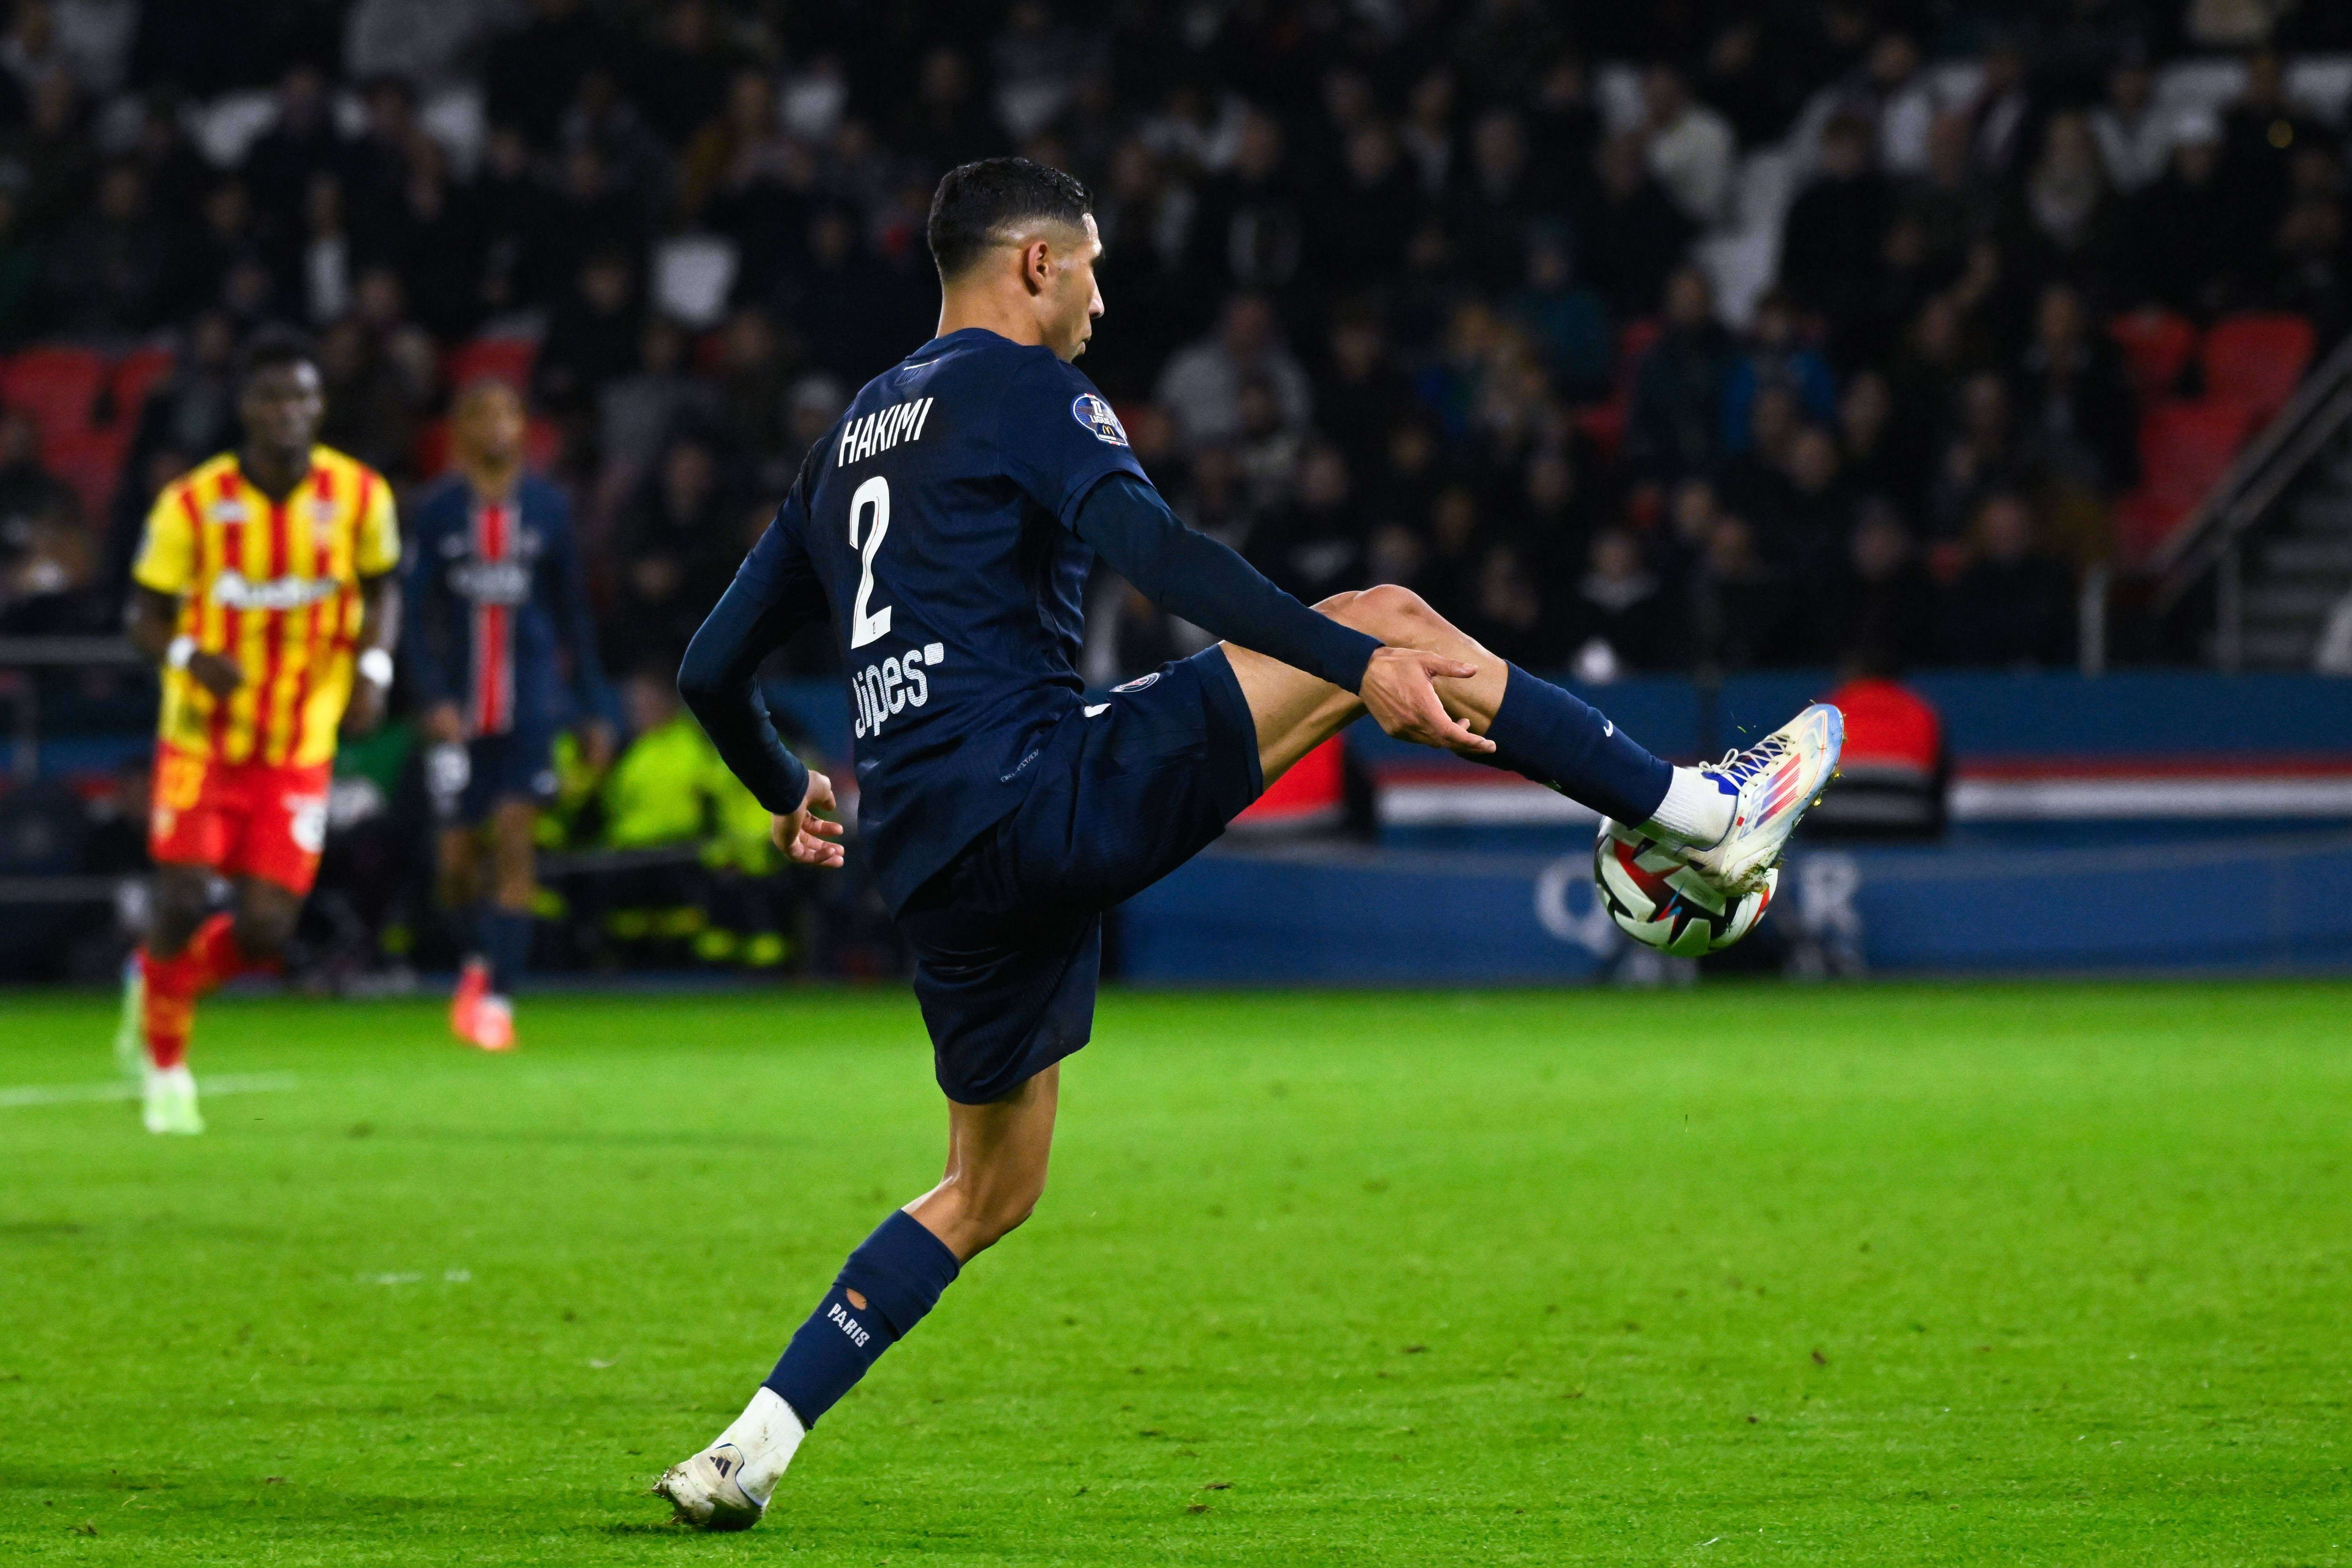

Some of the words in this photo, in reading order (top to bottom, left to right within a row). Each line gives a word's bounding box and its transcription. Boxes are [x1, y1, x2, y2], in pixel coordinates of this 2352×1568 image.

[838, 397, 933, 467] HAKIMI
[1089, 415, 1112, 426] LIGUE
[849, 476, 892, 649] 2
[827, 1303, 870, 1347] PARIS
